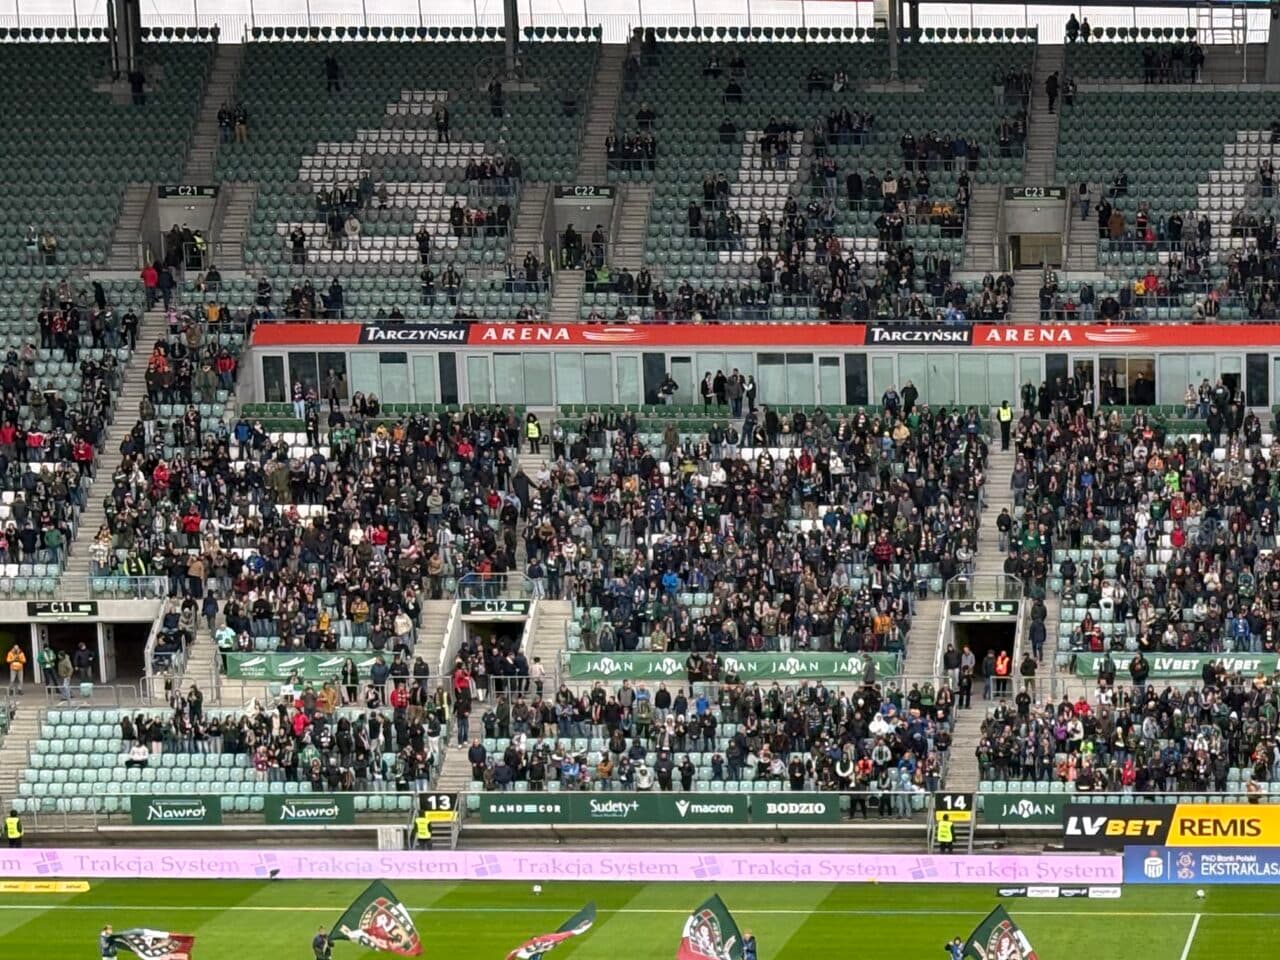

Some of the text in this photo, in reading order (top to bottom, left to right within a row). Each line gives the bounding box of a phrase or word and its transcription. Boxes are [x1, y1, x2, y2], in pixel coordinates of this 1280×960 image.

[178, 186, 198, 196] C21
[574, 186, 595, 196] C22
[1025, 187, 1045, 197] C23
[482, 328, 570, 340] ARENA
[986, 328, 1072, 341] ARENA
[51, 602, 72, 613] C11
[485, 601, 507, 611] C12
[973, 601, 995, 612] C13
[648, 657, 684, 675] JAXA
[1154, 658, 1199, 671] LVBET
[428, 796, 451, 810] 13
[691, 804, 734, 813] macron
[767, 803, 826, 814] BODZIO
[943, 795, 967, 810] 14
[1002, 799, 1055, 818] JAXAN
[147, 805, 207, 820] Nawrot
[280, 805, 339, 820] Nawrot
[1179, 819, 1261, 837] REMIS
[74, 855, 153, 875] Trakcja
[293, 857, 368, 875] Trakcja
[513, 857, 593, 876] Trakcja
[732, 858, 812, 877] Trakcja
[951, 860, 1029, 879] Trakcja
